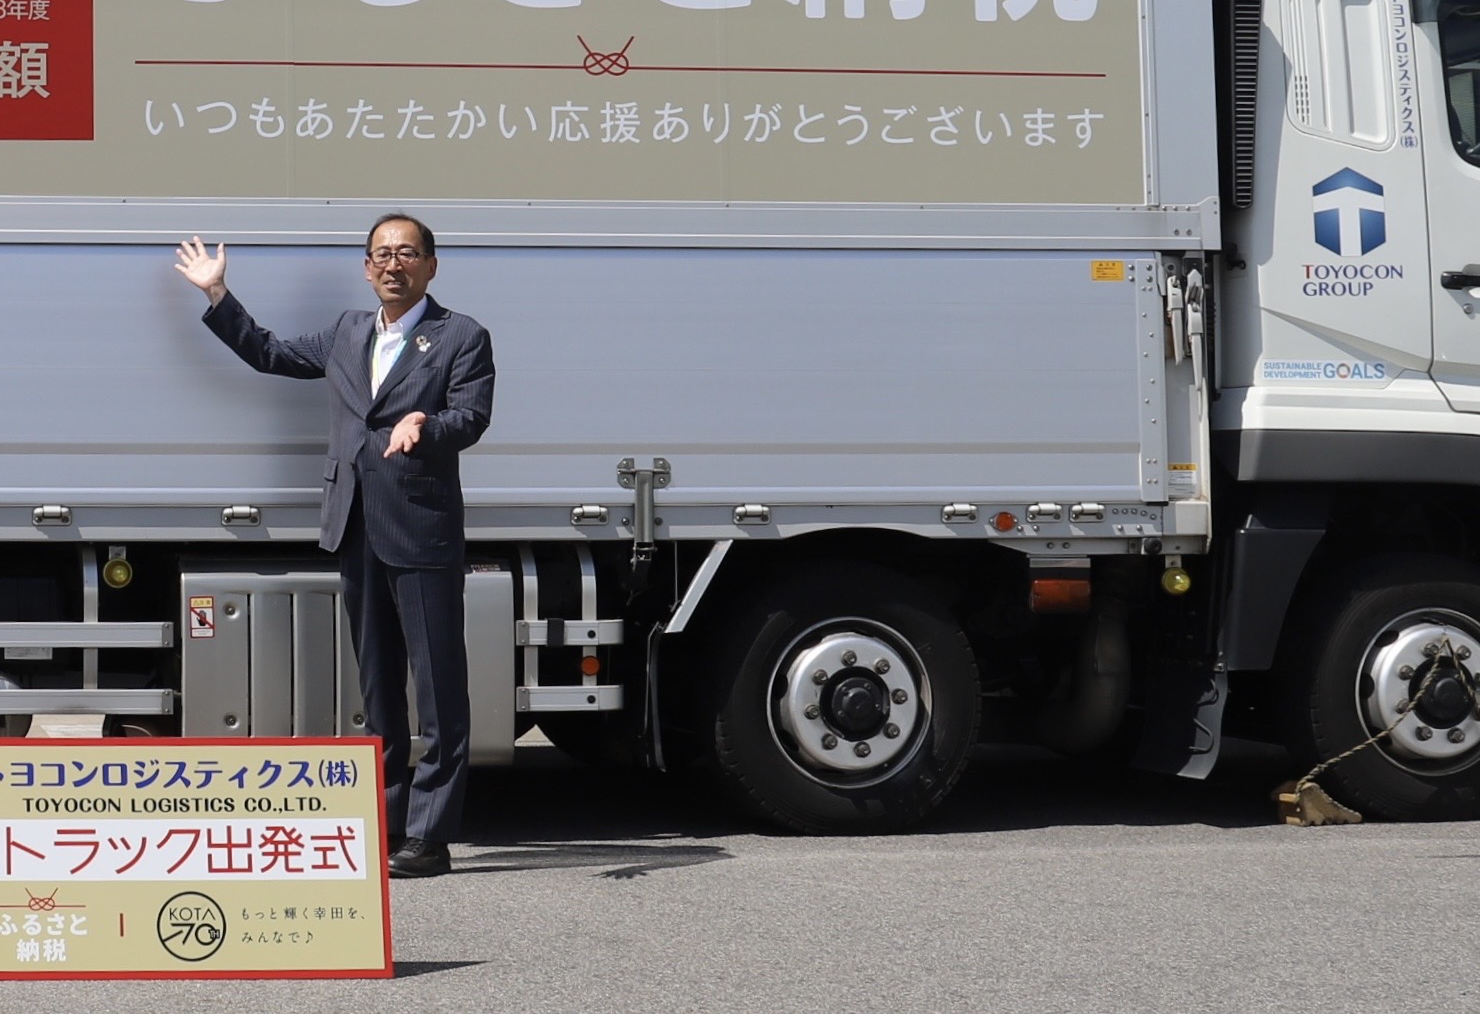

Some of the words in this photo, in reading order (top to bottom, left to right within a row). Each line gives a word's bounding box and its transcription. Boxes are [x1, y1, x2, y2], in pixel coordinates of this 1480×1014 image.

[144, 96, 1106, 149] いつもあたたかい応援ありがとうございます
[1302, 264, 1403, 280] TOYOCON
[1302, 282, 1374, 297] GROUP
[1264, 362, 1321, 370] SUSTAINABLE
[1323, 362, 1385, 379] GOALS
[1264, 370, 1321, 379] DEVELOPMENT
[22, 798, 121, 813] TOYOCON
[131, 797, 235, 813] LOGISTICS
[244, 797, 327, 814] CO.,LTD.
[16, 937, 66, 962] 納税
